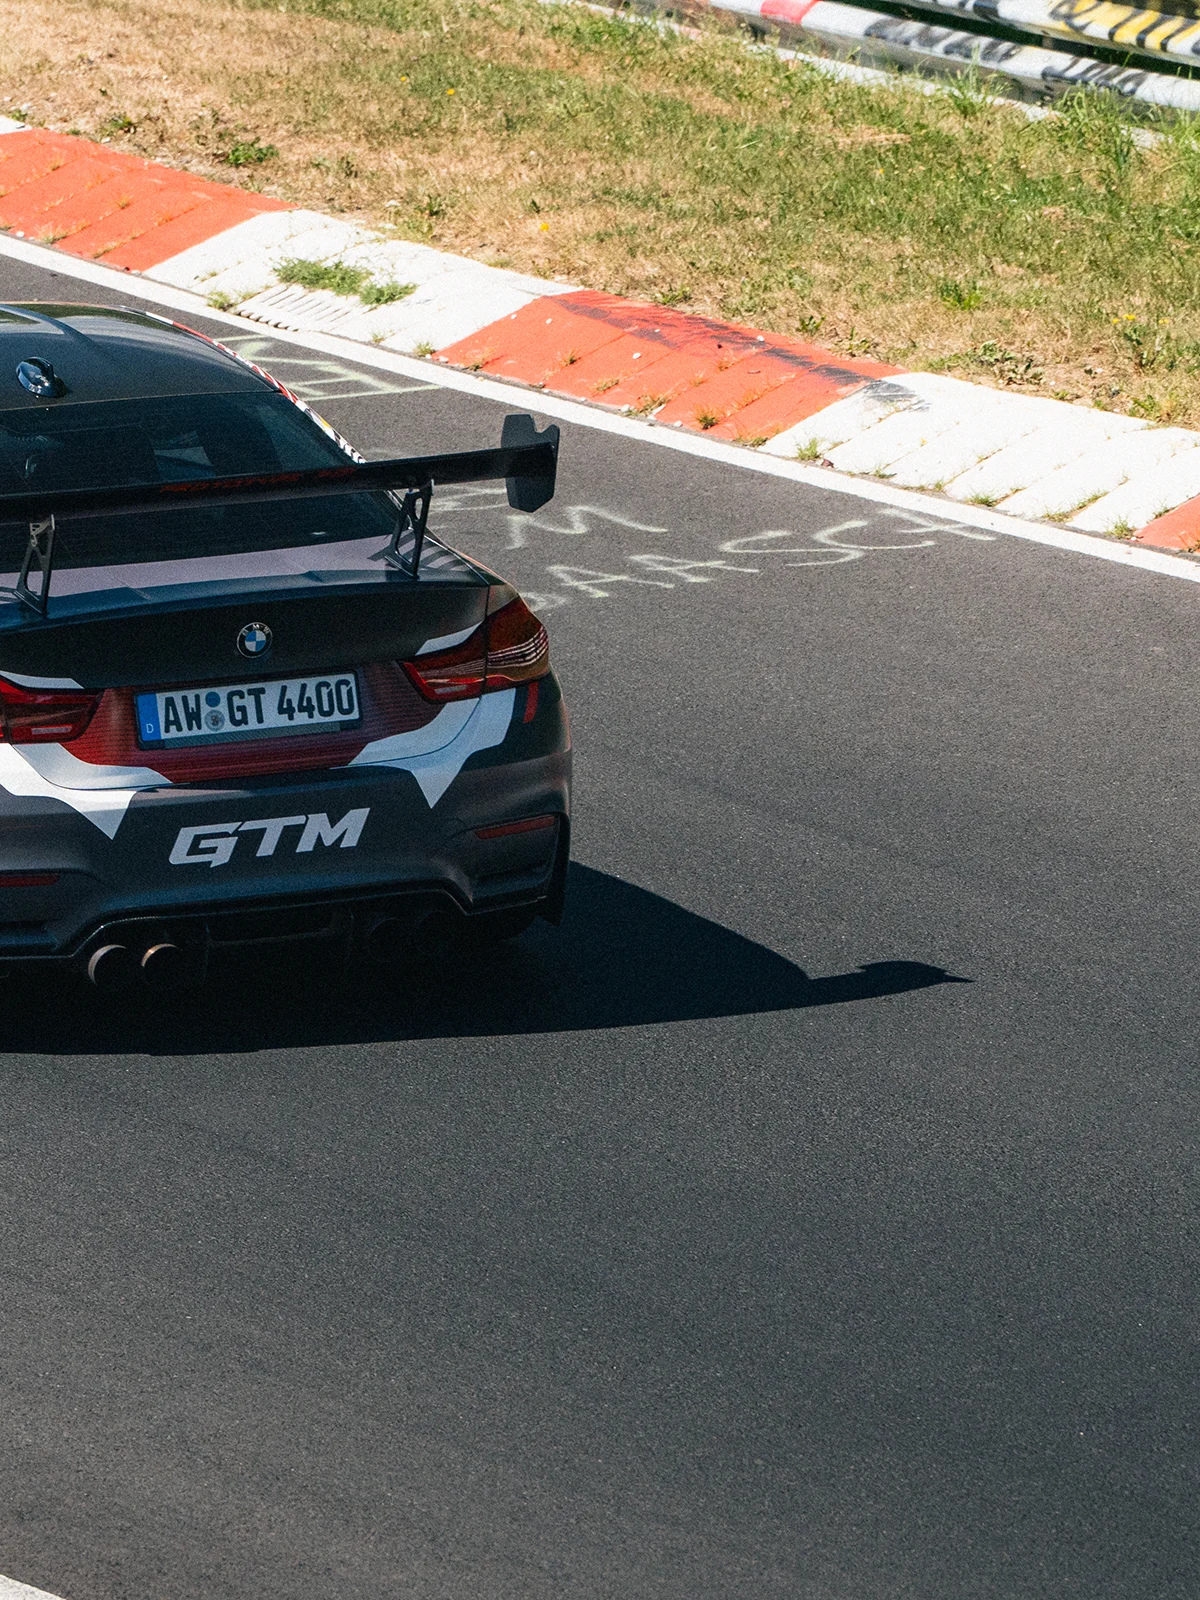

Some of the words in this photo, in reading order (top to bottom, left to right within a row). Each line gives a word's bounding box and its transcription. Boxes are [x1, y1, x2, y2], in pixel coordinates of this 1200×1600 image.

[145, 722, 155, 734] D
[163, 694, 203, 734] AW
[227, 687, 266, 727] GT
[277, 678, 353, 721] 4400
[168, 807, 371, 868] GTM
